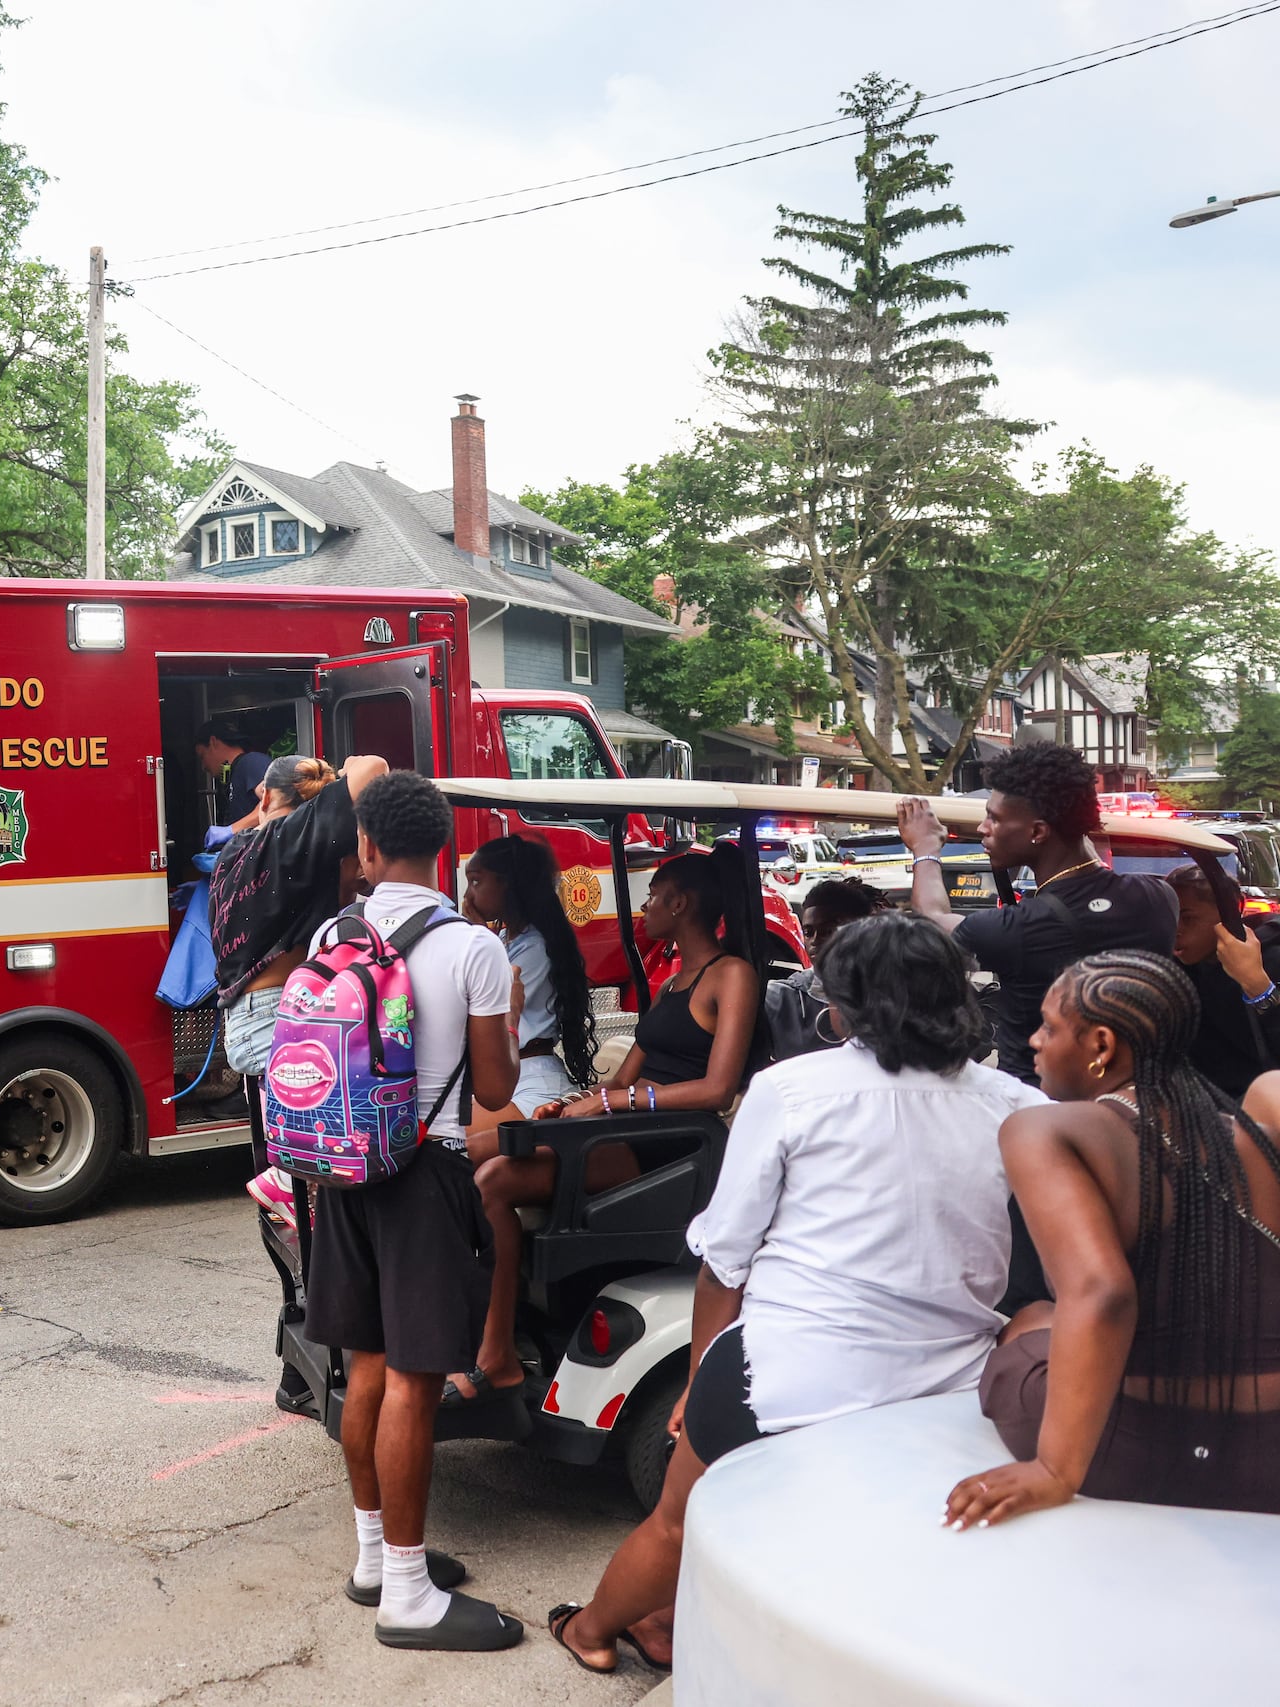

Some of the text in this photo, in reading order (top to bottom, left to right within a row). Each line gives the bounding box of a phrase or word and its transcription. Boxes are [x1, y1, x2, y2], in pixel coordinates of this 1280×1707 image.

[12, 808, 21, 849] MEDIC
[567, 867, 590, 879] TOLEDO
[572, 888, 587, 902] 16
[949, 888, 990, 899] SHERIFF
[570, 912, 590, 922] OHIO
